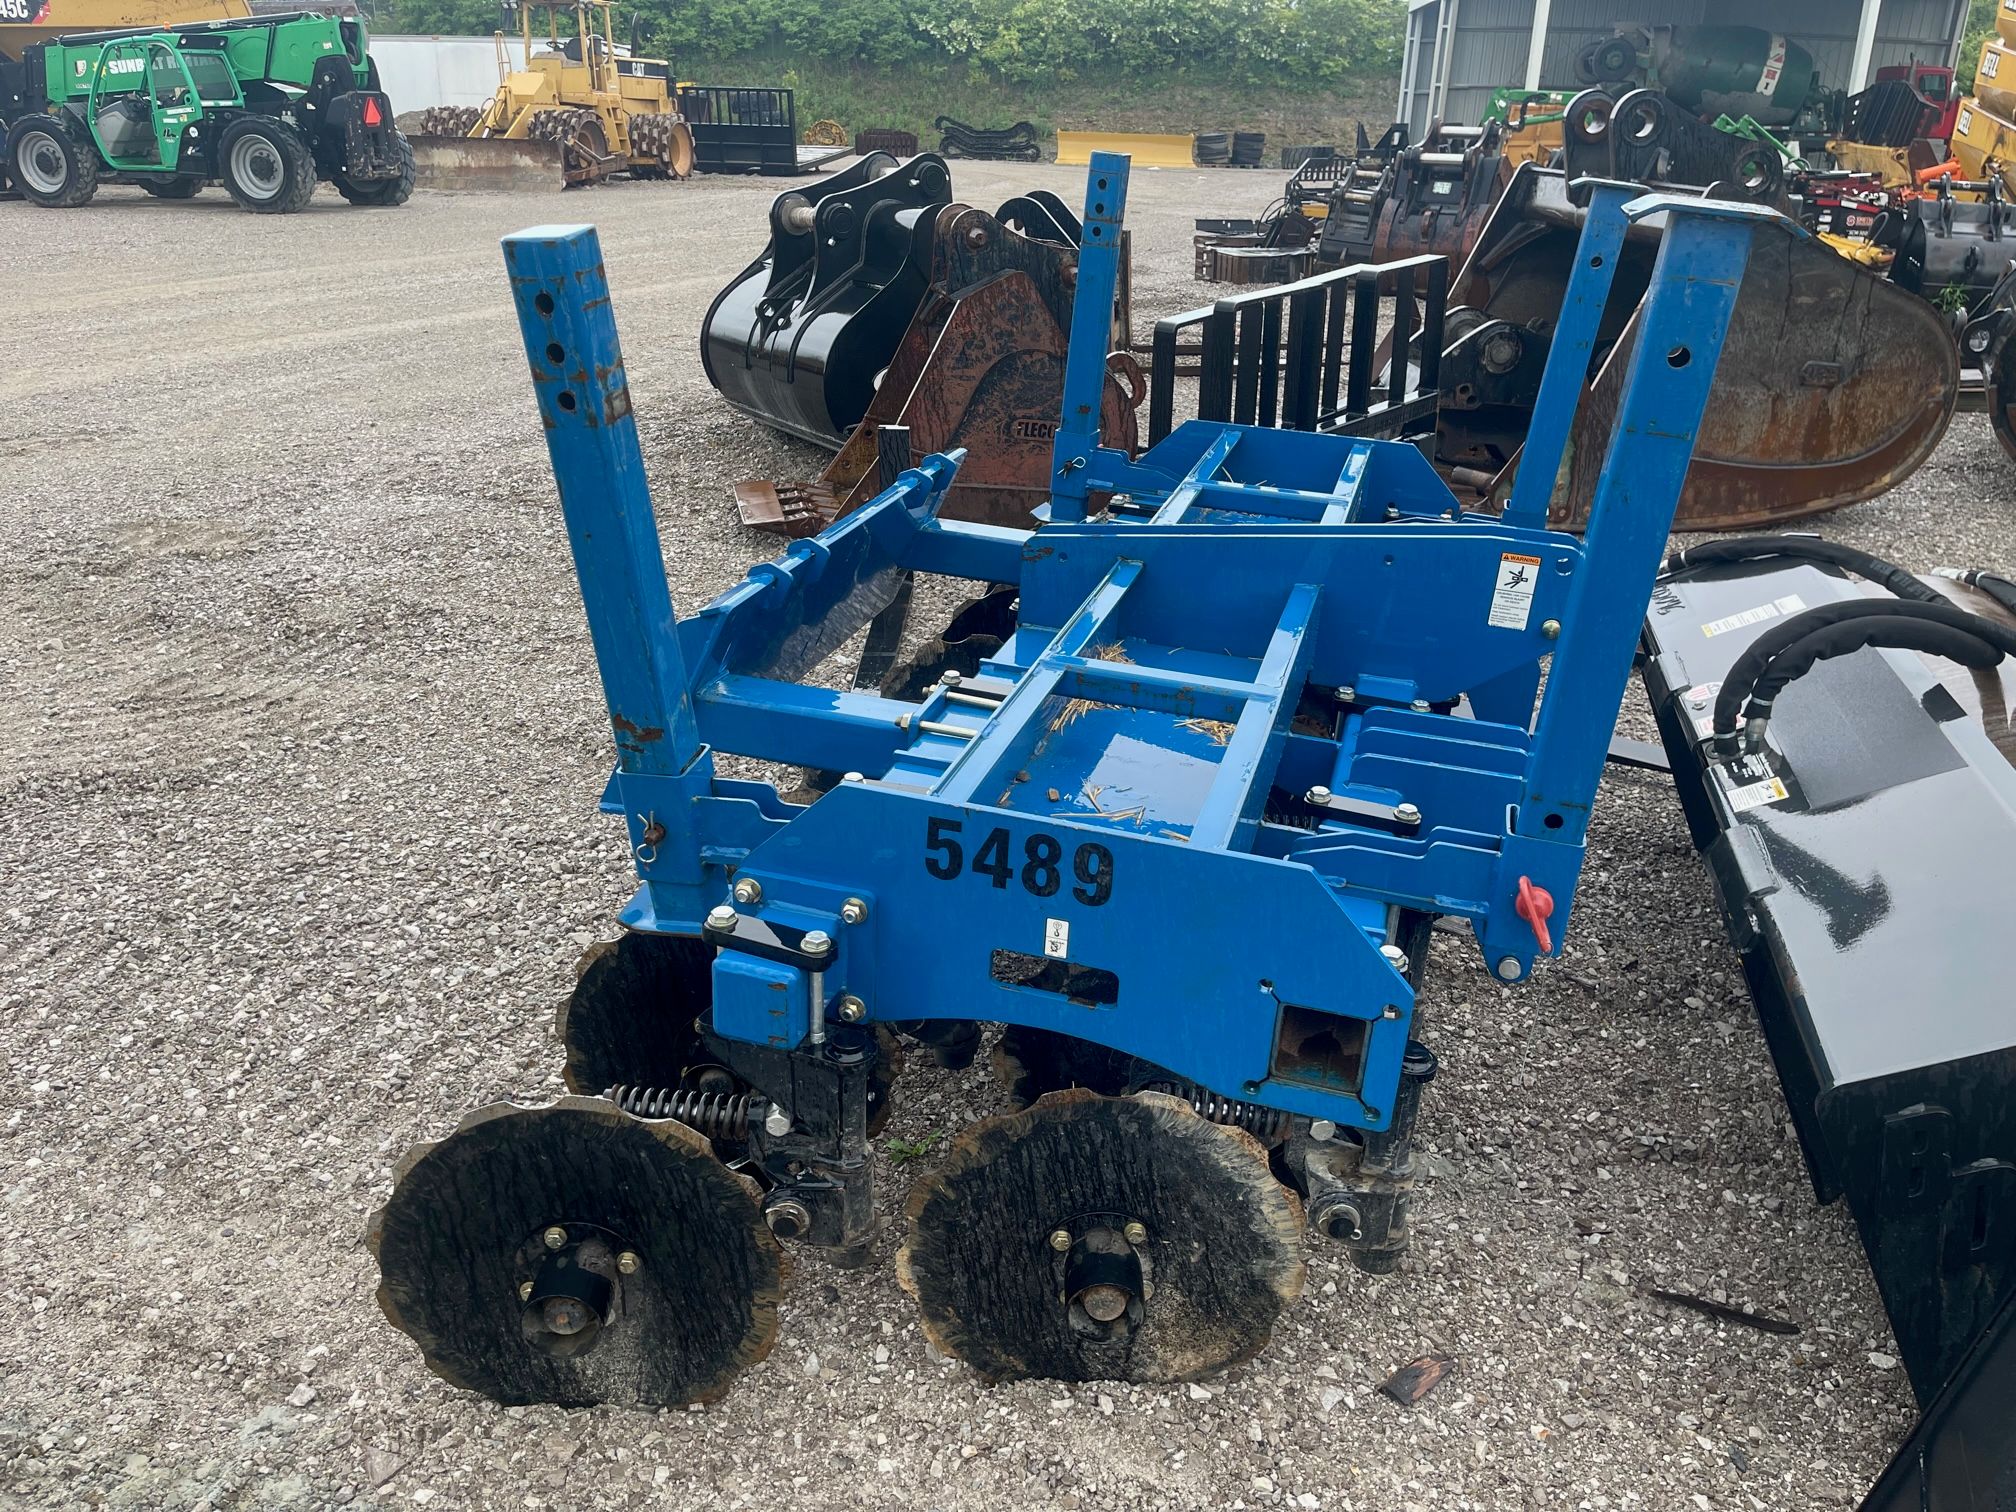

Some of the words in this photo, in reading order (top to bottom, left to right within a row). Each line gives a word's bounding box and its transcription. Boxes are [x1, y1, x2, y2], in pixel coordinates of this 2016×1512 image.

[108, 56, 164, 74] SUNBLT
[632, 62, 645, 77] CAT
[1510, 555, 1539, 564] WARNING
[925, 816, 1113, 907] 5489
